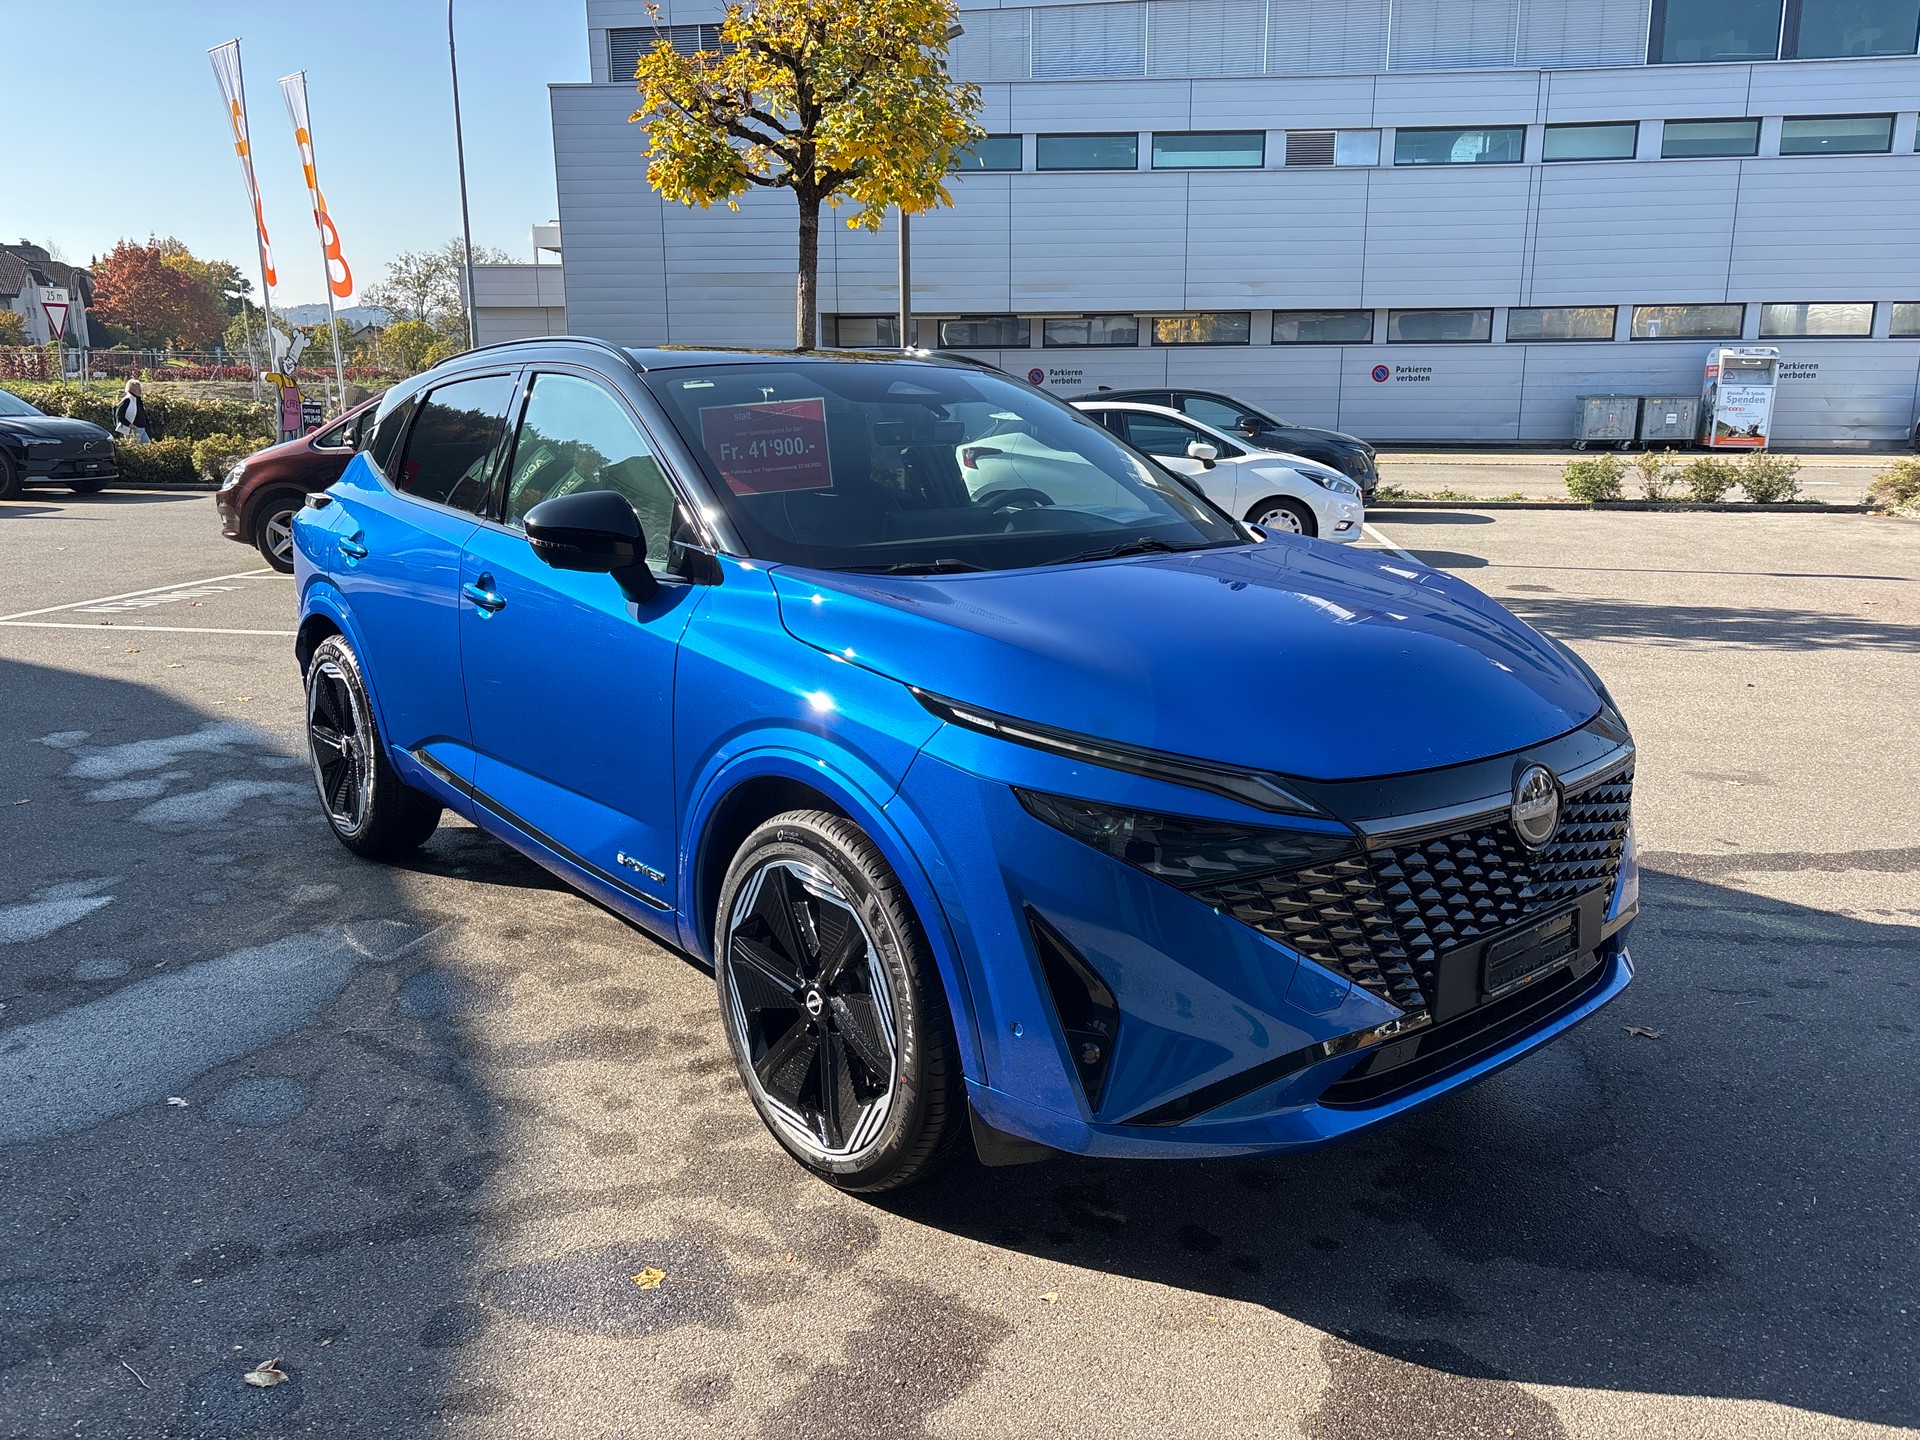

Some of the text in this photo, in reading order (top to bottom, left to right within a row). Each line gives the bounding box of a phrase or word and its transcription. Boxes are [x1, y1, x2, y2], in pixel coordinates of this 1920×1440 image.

[46, 290, 63, 301] 25 m
[1395, 365, 1432, 373] Parkieren
[1779, 362, 1819, 370] Parkieren
[1396, 374, 1431, 382] verboten
[1779, 371, 1817, 379] verboten
[1050, 377, 1082, 385] verboten
[1726, 395, 1766, 406] Spenden
[734, 411, 752, 421] statt
[720, 443, 744, 461] Fr.
[883, 943, 917, 1082] MICHELIN
